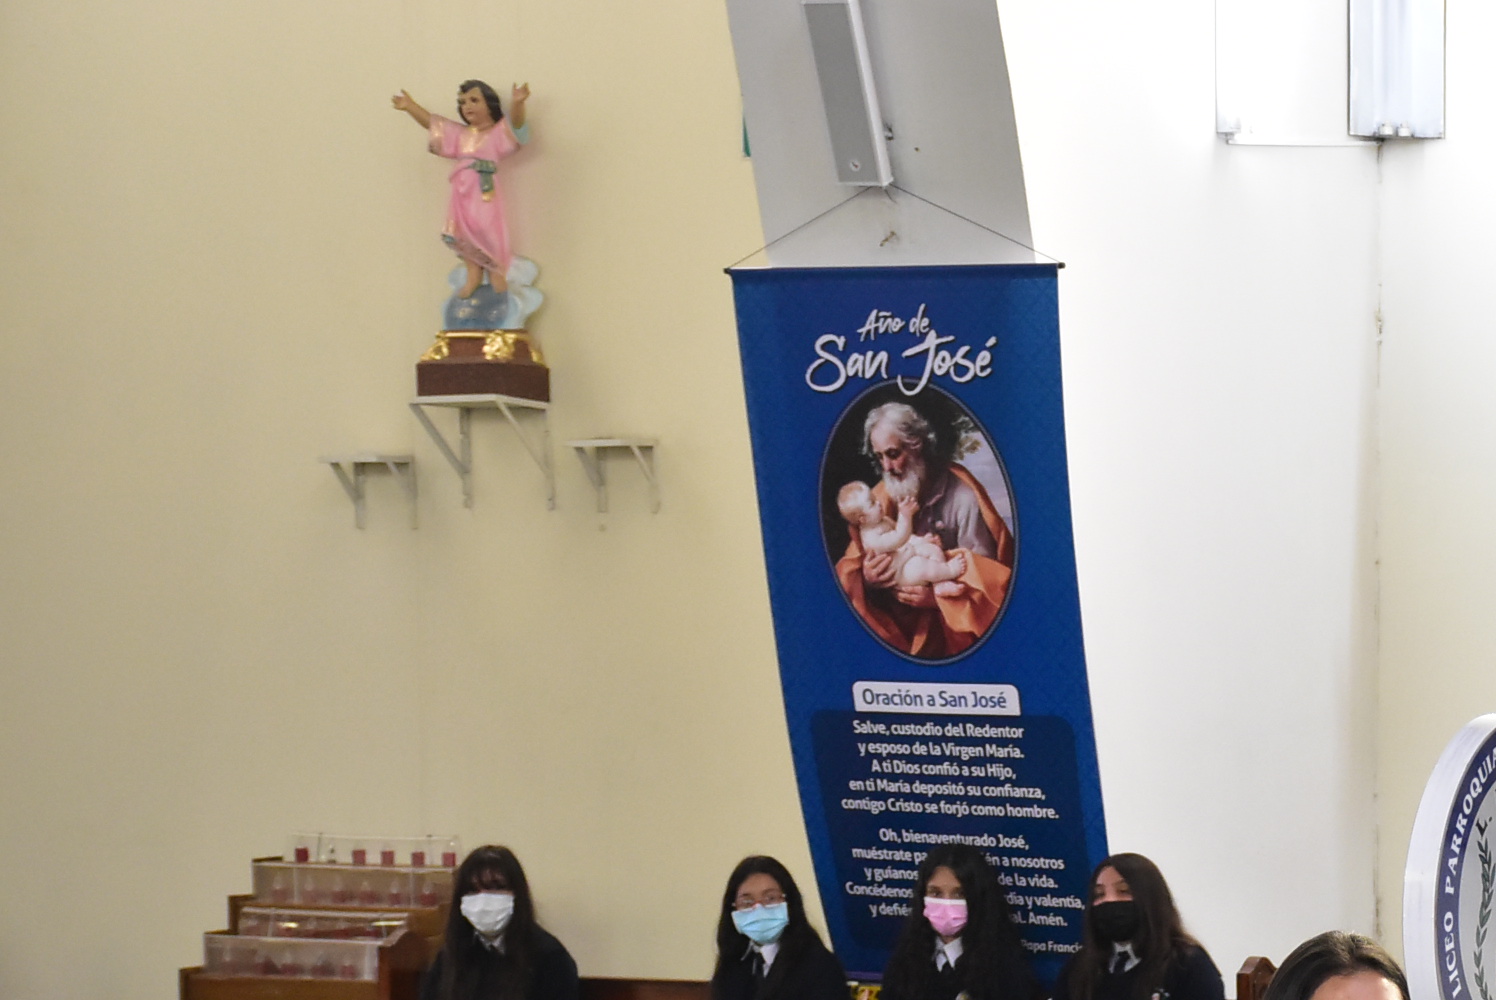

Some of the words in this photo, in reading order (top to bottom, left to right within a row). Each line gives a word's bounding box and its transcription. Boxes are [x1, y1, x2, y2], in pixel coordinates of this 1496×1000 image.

[857, 308, 905, 341] Año
[909, 303, 930, 333] de
[805, 334, 889, 392] San
[897, 329, 998, 395] José
[862, 688, 923, 706] Oración
[927, 695, 936, 707] a
[938, 691, 968, 708] San
[971, 691, 1007, 709] José
[852, 720, 890, 736] Salve,
[891, 722, 942, 736] custodio
[944, 723, 965, 737] del
[966, 723, 1024, 738] Redentor
[857, 742, 866, 756] y
[868, 742, 911, 757] esposo
[912, 741, 927, 755] de
[929, 742, 941, 756] la
[941, 742, 984, 761] Virgen
[985, 743, 1024, 759] María.
[871, 759, 882, 773] A
[882, 759, 892, 773] ti
[892, 760, 921, 774] Dios
[921, 762, 959, 776] confió
[961, 765, 970, 776] a
[971, 765, 986, 777] su
[986, 763, 1016, 780] Hijo,
[849, 779, 865, 791] en
[865, 778, 875, 792] ti
[876, 778, 911, 793] María
[912, 780, 965, 797] depositó
[966, 784, 981, 796] su
[982, 783, 1046, 800] confianza,
[841, 797, 886, 814] contigo
[887, 797, 923, 813] Cristo
[924, 802, 939, 814] se
[939, 800, 970, 818] forjó
[970, 805, 1005, 816] como
[1006, 803, 1059, 819] hombre.
[879, 828, 901, 843] Oh,
[901, 829, 997, 848] bienaventurado
[997, 833, 1029, 850] José,
[851, 846, 912, 862] muéstrate
[1002, 857, 1010, 867] a
[1011, 856, 1065, 870] nosotros
[863, 867, 872, 881] y
[873, 865, 919, 882] guíanos
[997, 872, 1013, 885] de
[1014, 873, 1027, 887] la
[1027, 874, 1059, 888] vida.
[845, 881, 915, 899] Concédenos
[1025, 895, 1034, 909] y
[1034, 894, 1086, 910] valentía,
[869, 903, 878, 918] y
[1028, 912, 1068, 927] Amén.
[1443, 911, 1462, 999] LICEO
